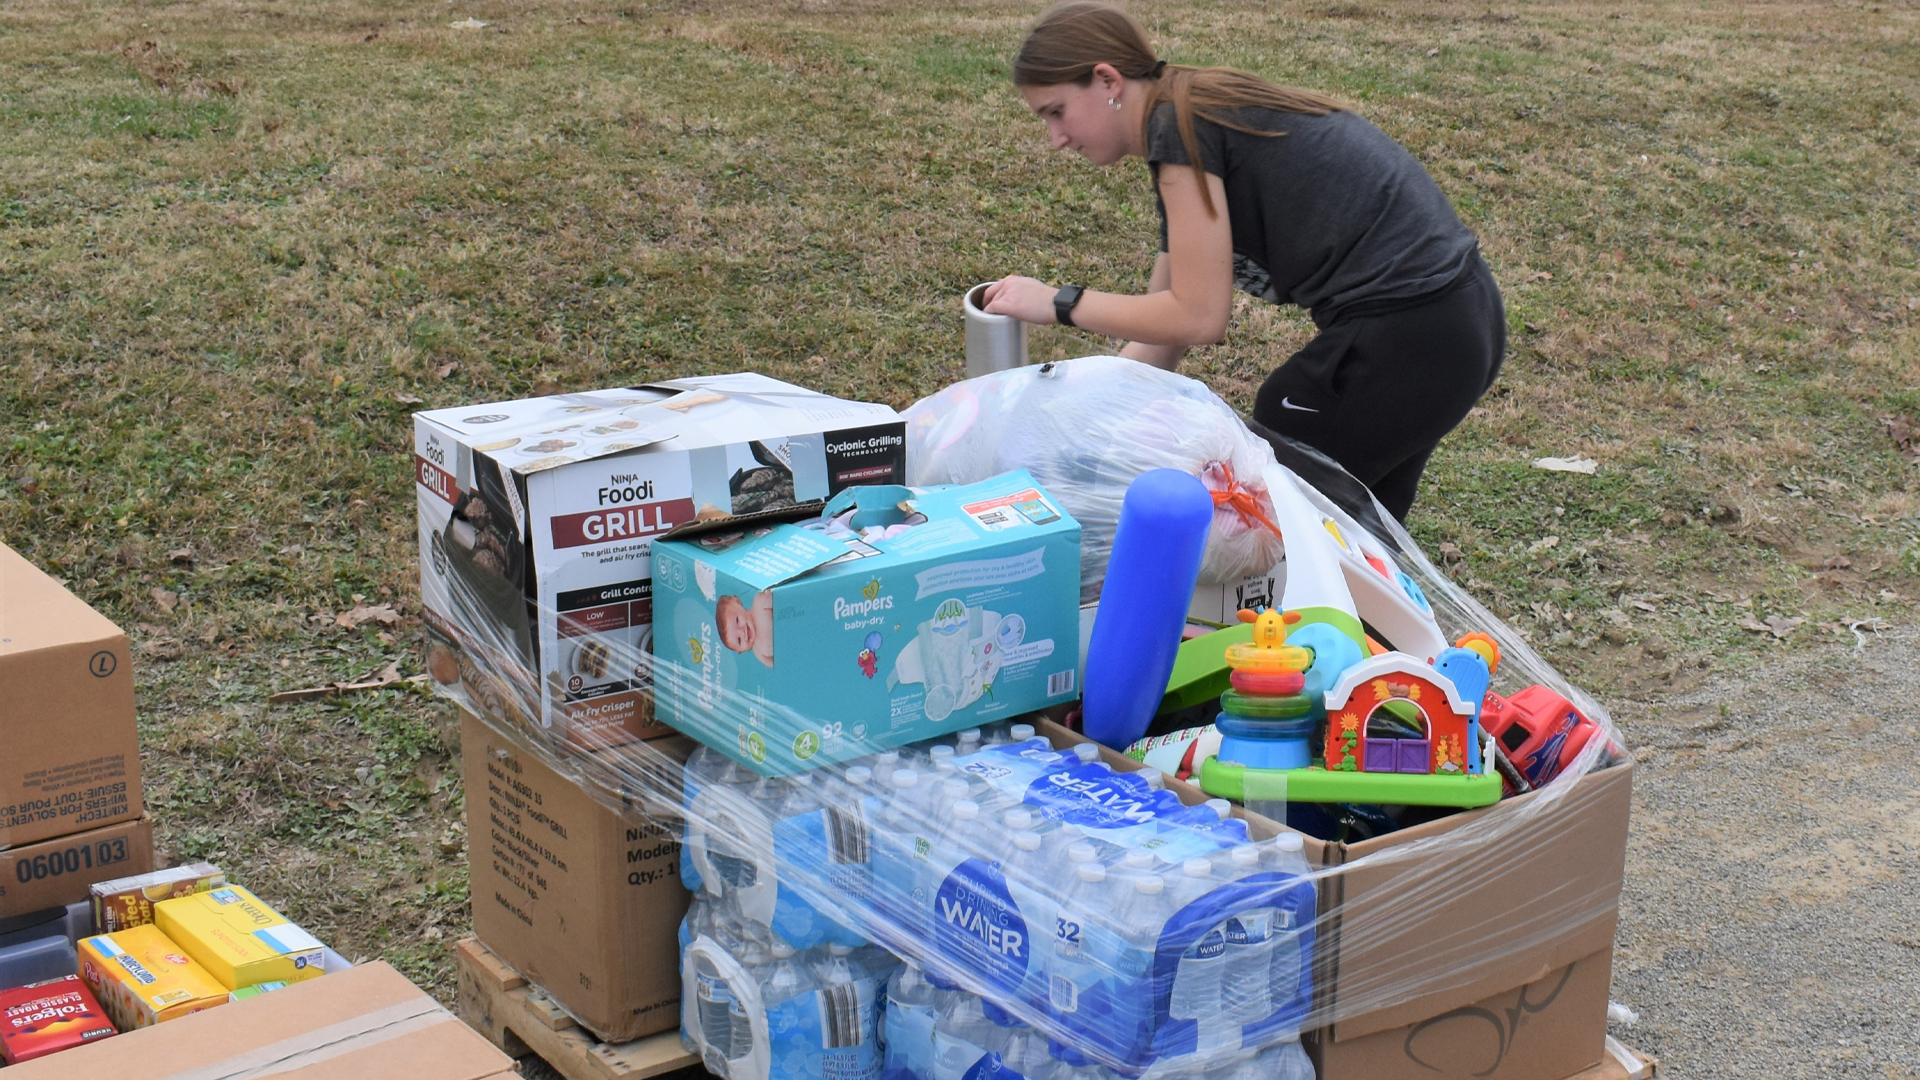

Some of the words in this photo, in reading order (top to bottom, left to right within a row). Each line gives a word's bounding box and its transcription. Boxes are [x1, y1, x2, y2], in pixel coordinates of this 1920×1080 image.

[426, 442, 444, 466] Foodi
[826, 441, 866, 454] Cyclonic
[868, 435, 902, 447] Grilling
[843, 447, 888, 457] TECHNOLOGY
[422, 462, 450, 500] GRILL
[611, 474, 638, 486] NINJA
[598, 480, 654, 505] Foodi
[582, 506, 673, 540] GRILL
[597, 548, 611, 557] grill
[626, 553, 635, 561] fry
[954, 567, 981, 575] protection
[601, 589, 621, 600] Grill
[922, 581, 948, 592] protection
[587, 612, 604, 620] LOW
[834, 595, 893, 620] Pampers
[844, 616, 884, 630] baby-dry
[698, 622, 713, 710] Pampers
[572, 708, 585, 720] Air
[587, 706, 600, 717] Fry
[601, 699, 634, 714] Crisper
[891, 707, 902, 717] 2X
[822, 722, 843, 739] 92
[800, 734, 812, 750] 4
[66, 776, 92, 786] Solvents
[104, 770, 125, 781] Wipers
[488, 762, 504, 780] Model
[535, 792, 542, 805] 15
[42, 784, 60, 792] White
[55, 782, 126, 802] ESSUIE-TOUT
[1048, 772, 1155, 823] WATER
[20, 798, 50, 812] POUR
[60, 804, 82, 815] FOR
[87, 795, 128, 810] WIPERS
[550, 820, 567, 839] GRILL
[100, 840, 125, 864] 03
[627, 841, 679, 863] Model:
[16, 844, 92, 884] 06001
[628, 869, 662, 886] Qty.:
[668, 862, 676, 875] 1
[119, 896, 139, 926] sted
[140, 900, 153, 924] Oats
[240, 902, 272, 924] Cheerios
[496, 892, 510, 910] Made
[517, 908, 532, 926] China
[956, 887, 1009, 926] DRINKING
[941, 896, 1023, 957] WATER
[1056, 917, 1080, 943] 32
[1227, 932, 1246, 940] ATER
[1200, 943, 1224, 955] WATER
[85, 962, 98, 982] Post
[41, 995, 82, 1007] CLASSIC
[634, 1005, 652, 1015] Made
[7, 1005, 39, 1017] ROAST
[12, 1003, 89, 1026] Folgers
[83, 1028, 111, 1038] KEURIG
